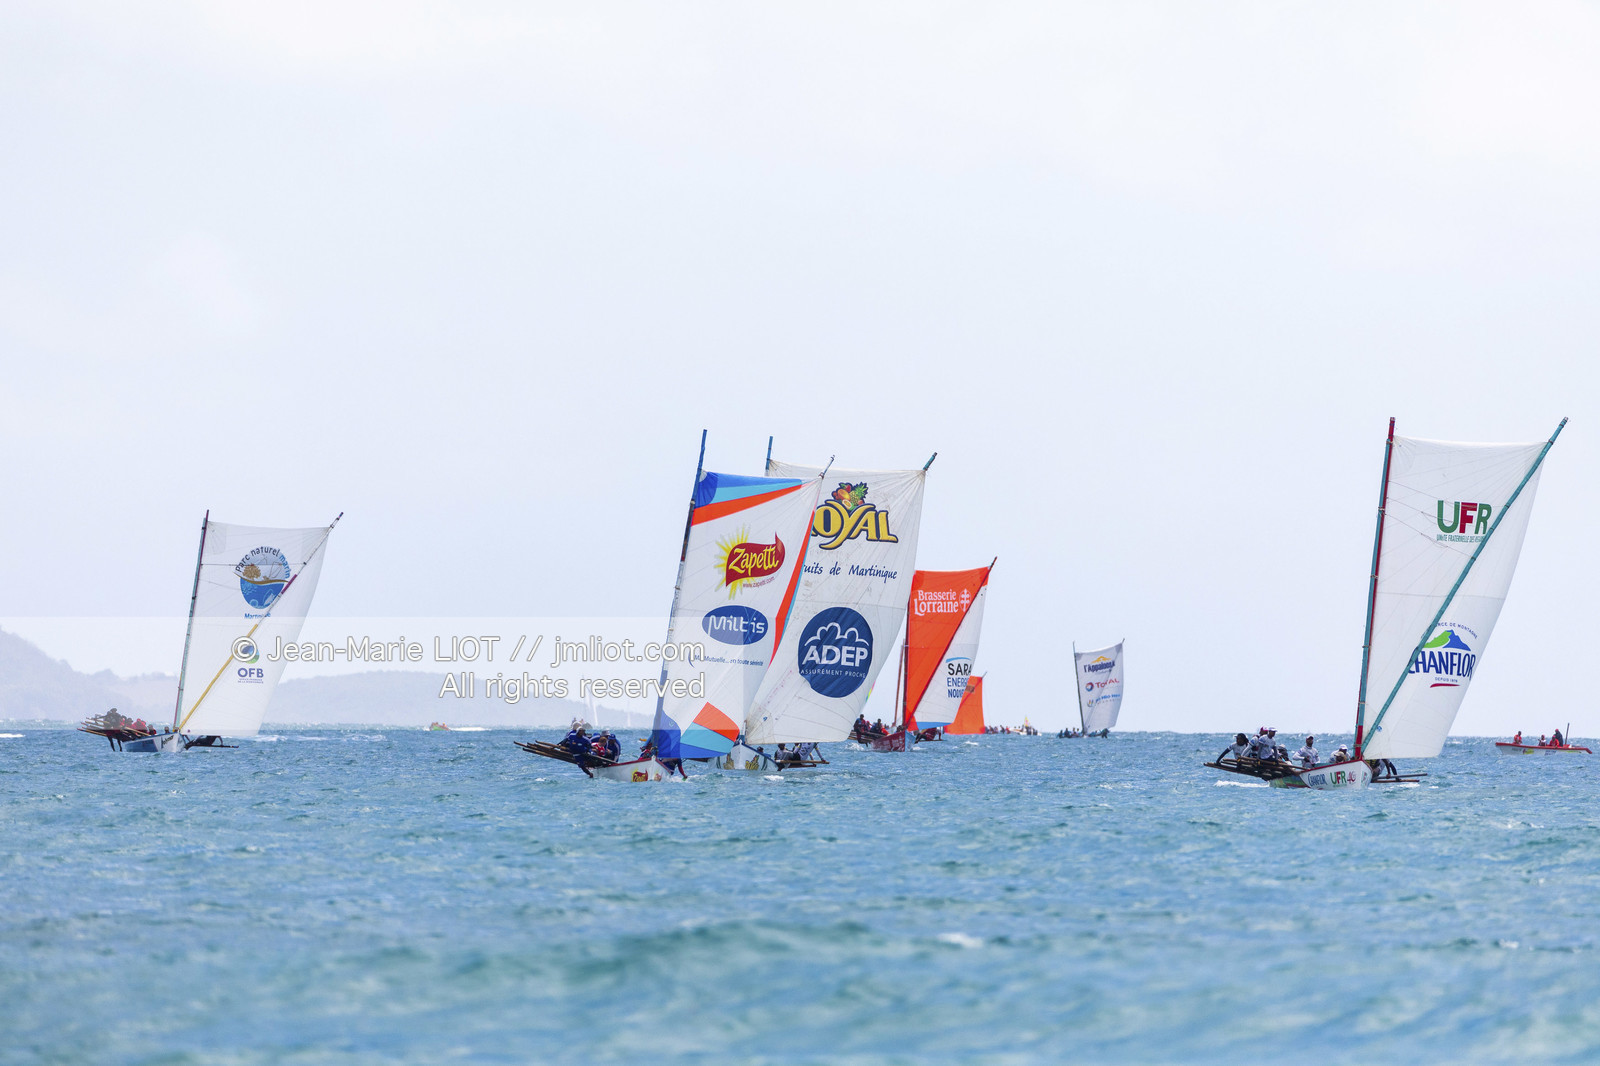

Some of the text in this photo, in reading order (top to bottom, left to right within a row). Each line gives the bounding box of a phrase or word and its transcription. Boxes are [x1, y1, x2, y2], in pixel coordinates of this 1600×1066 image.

[811, 499, 899, 550] OYAL
[1437, 499, 1492, 535] UFR
[235, 546, 292, 579] parc naturel marin
[728, 545, 780, 576] Zapetti
[829, 561, 842, 576] de
[848, 564, 898, 583] Martinique
[917, 588, 957, 601] Brasserie
[914, 598, 959, 616] Lorraine
[707, 615, 765, 637] Miltis
[802, 645, 869, 667] ADEP
[237, 667, 264, 678] OFB
[1095, 678, 1120, 689] TOTAL
[1330, 770, 1347, 785] UFR
